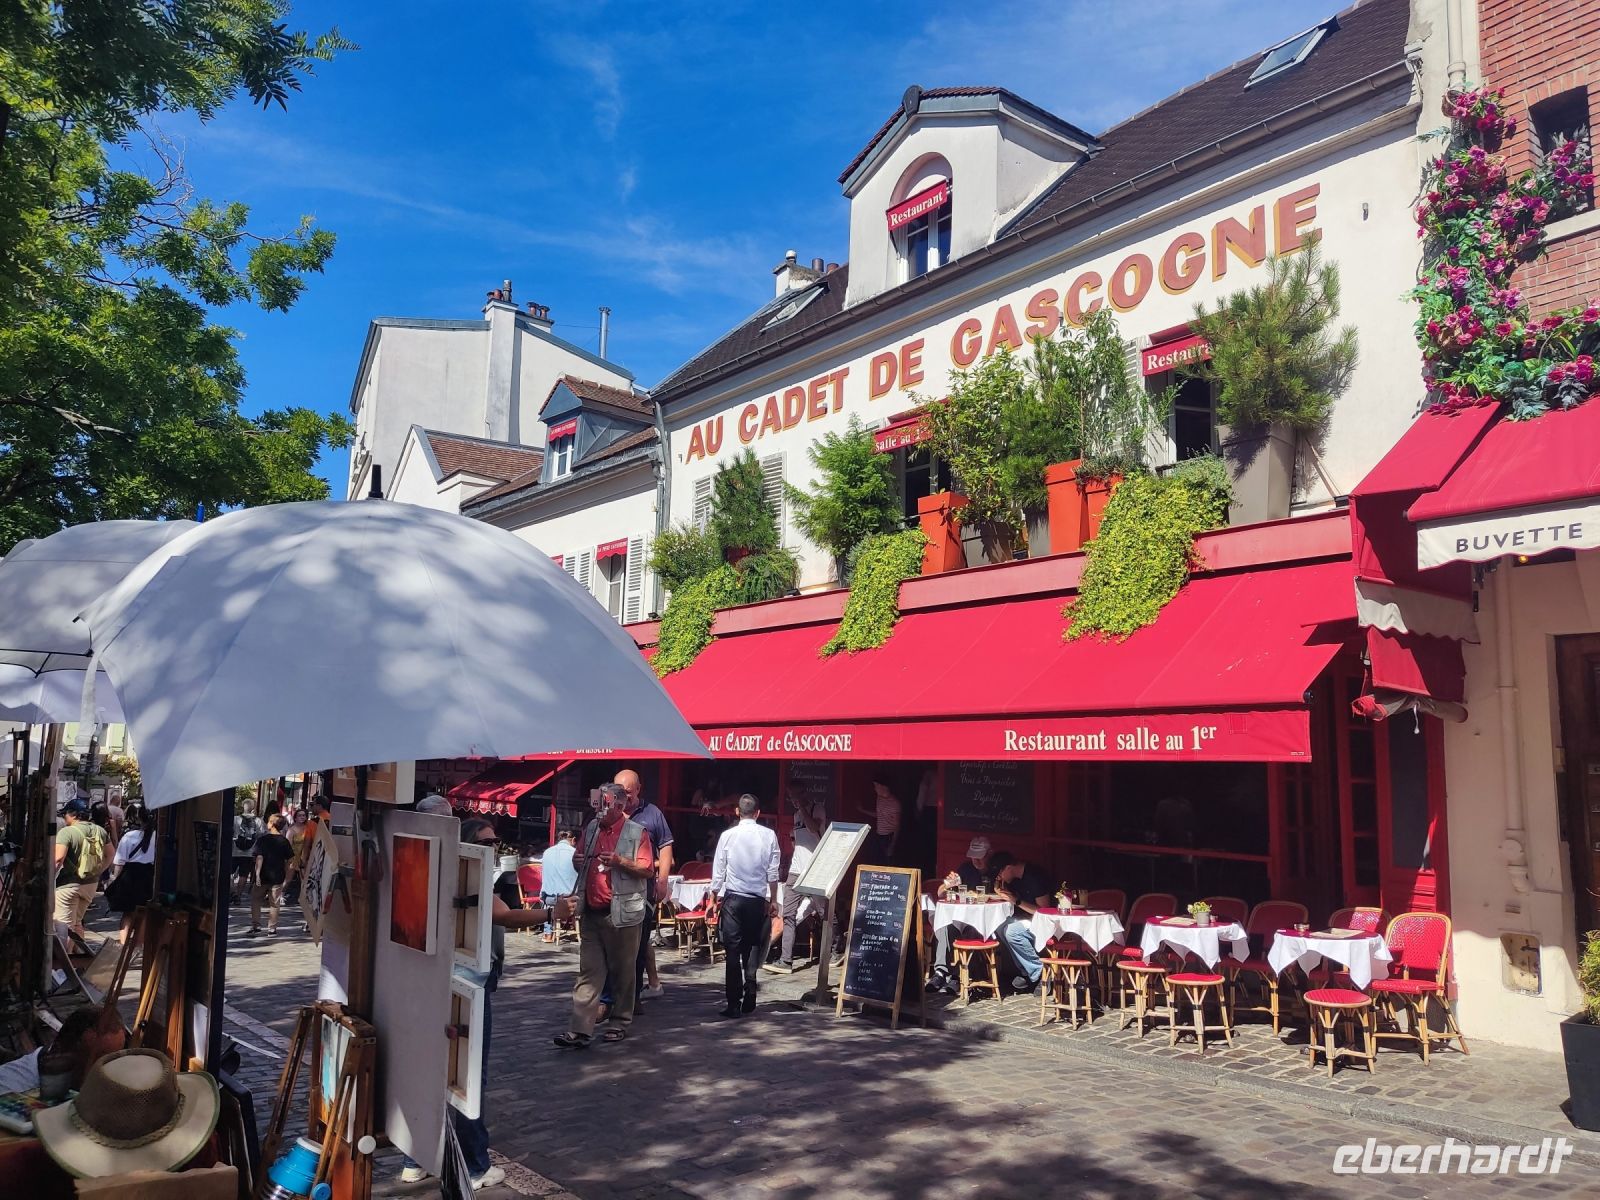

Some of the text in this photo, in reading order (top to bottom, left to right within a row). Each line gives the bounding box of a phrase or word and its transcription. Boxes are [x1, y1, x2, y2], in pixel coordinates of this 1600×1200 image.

[890, 190, 943, 227] Restaurant
[685, 182, 1323, 465] AU CADET DE GASCOGNE
[875, 437, 897, 452] salle
[1456, 522, 1583, 553] BUVETTE
[708, 729, 852, 752] AU CADET de GASCOGNE
[1004, 725, 1218, 751] Restaurant salle au 1er
